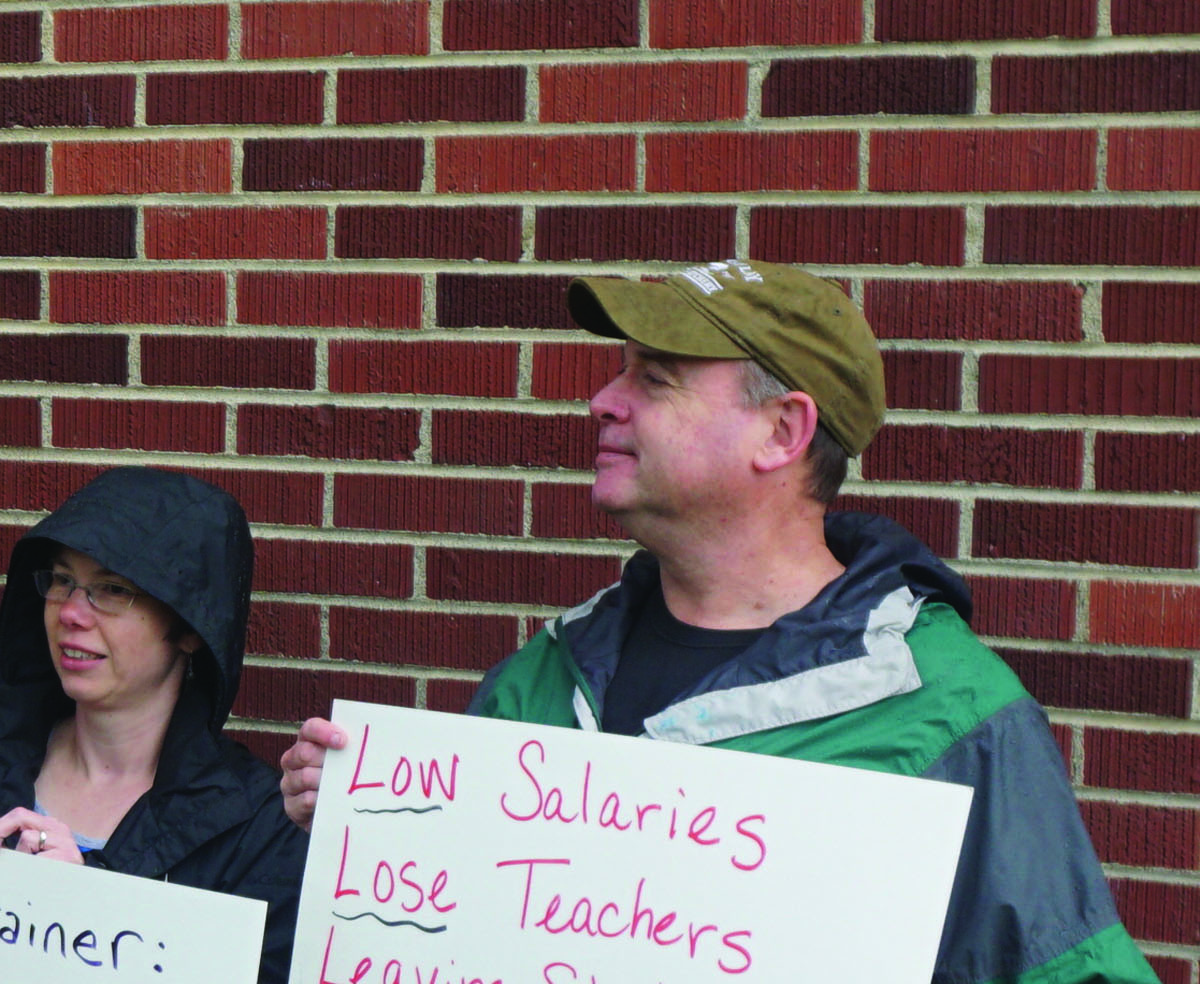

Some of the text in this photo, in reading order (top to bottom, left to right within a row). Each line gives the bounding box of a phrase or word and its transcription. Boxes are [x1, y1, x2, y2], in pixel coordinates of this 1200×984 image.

[500, 740, 767, 871] Salaries
[333, 825, 753, 974] Lose Teachers
